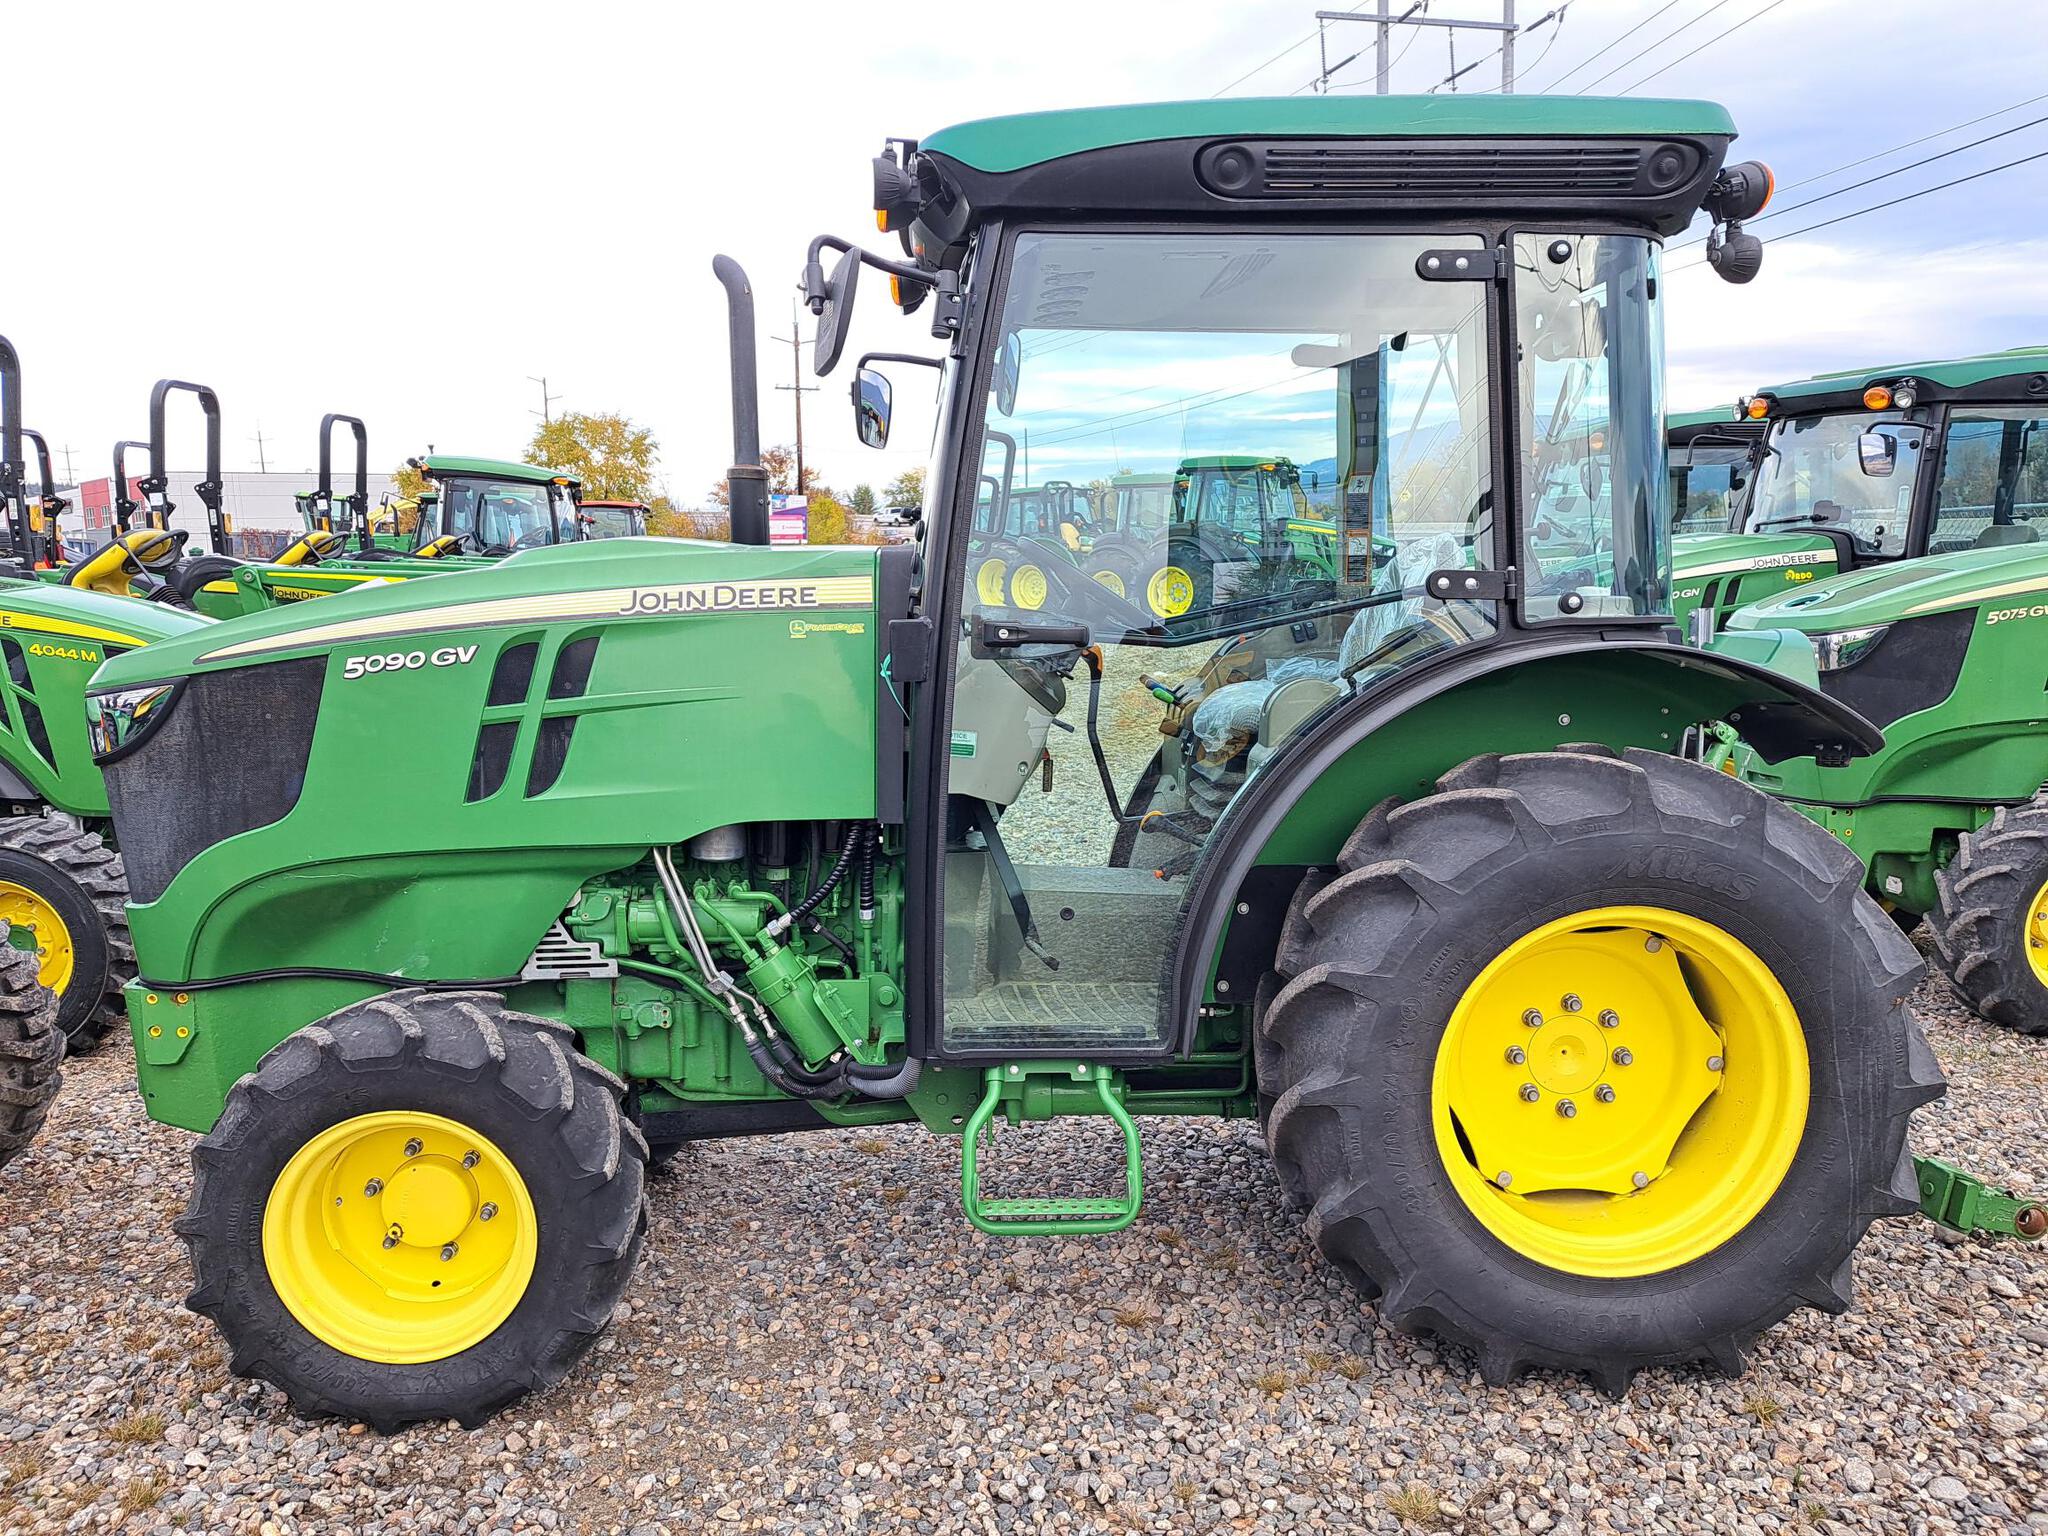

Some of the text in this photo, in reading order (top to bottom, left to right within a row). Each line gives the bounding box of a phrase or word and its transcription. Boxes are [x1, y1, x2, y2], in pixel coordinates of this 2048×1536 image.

[1751, 553, 1818, 570] JOHN DEERE
[274, 588, 300, 598] JOHN
[619, 585, 817, 613] JOHN DEERE
[1985, 607, 2028, 625] 5075
[28, 643, 98, 663] 4044 M
[343, 644, 480, 680] 5090 GV
